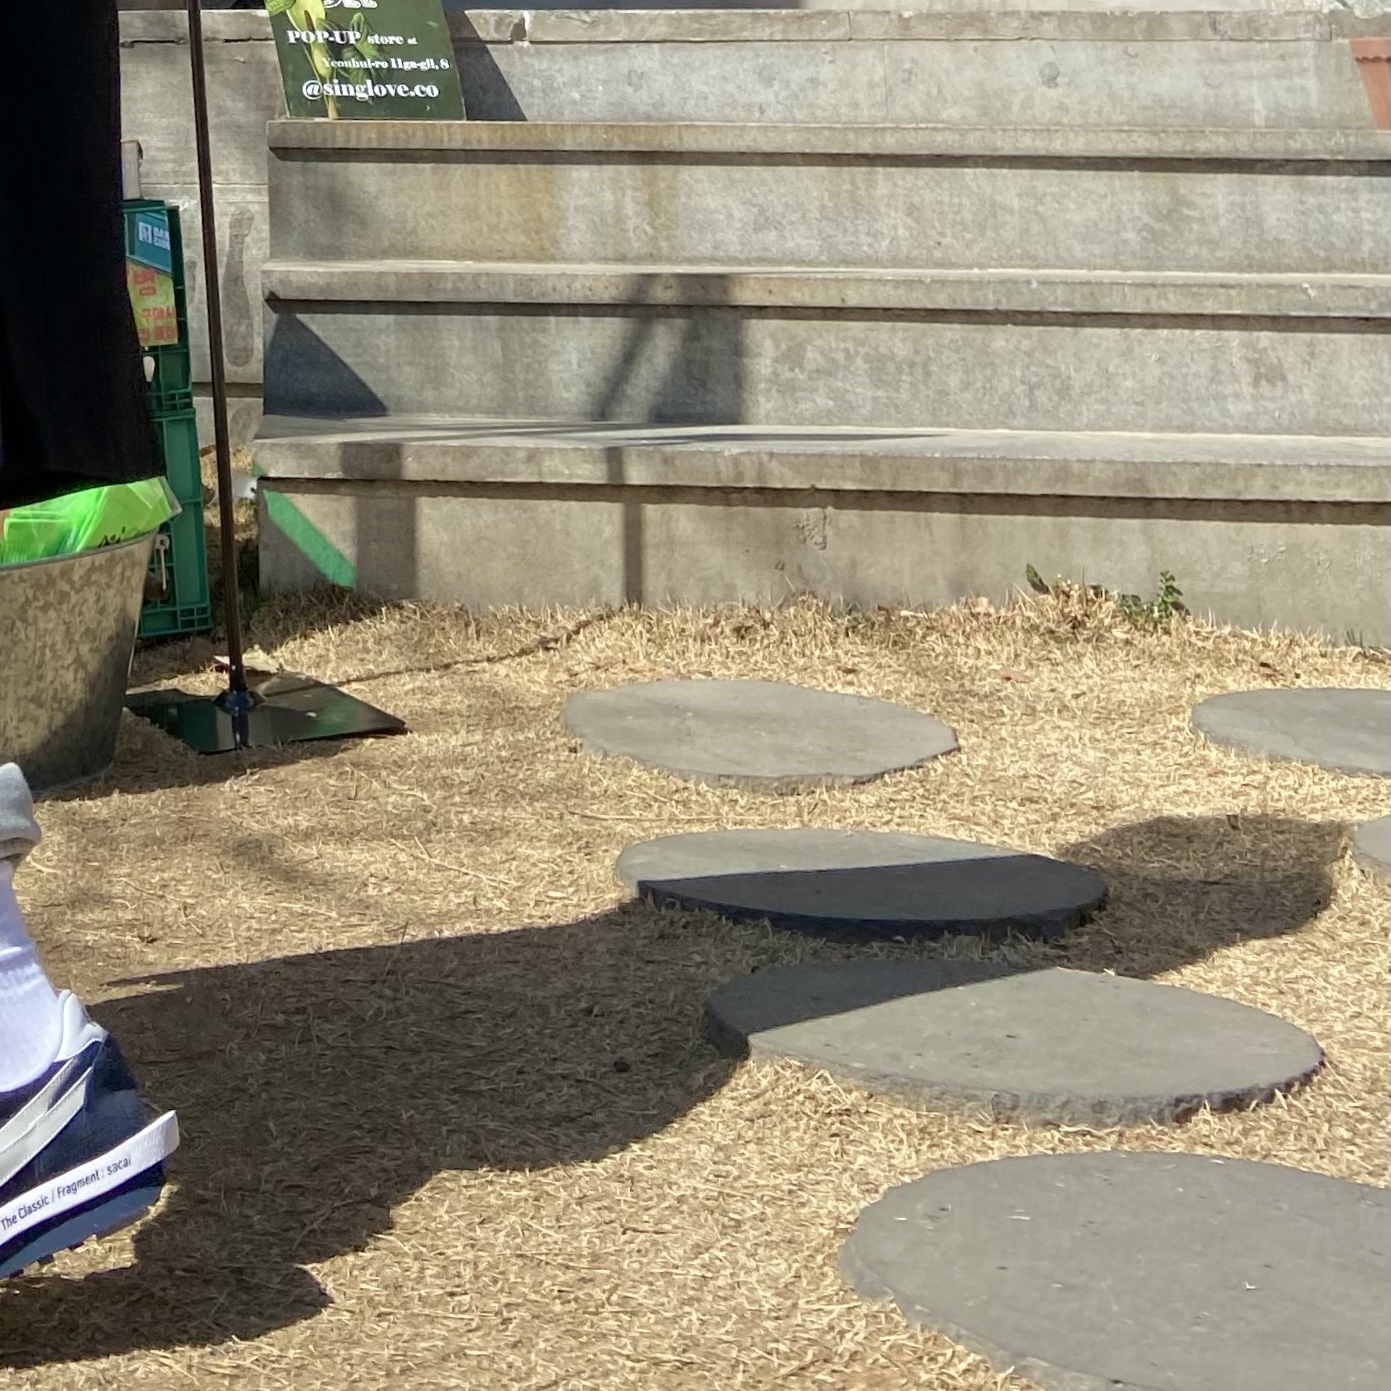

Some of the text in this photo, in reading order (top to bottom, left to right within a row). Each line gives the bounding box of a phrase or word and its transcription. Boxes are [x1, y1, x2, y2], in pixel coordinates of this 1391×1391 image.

[287, 30, 418, 45] POP-UP store at
[440, 58, 450, 70] 8
[301, 79, 439, 101] @singlove.co
[0, 1215, 18, 1231] The
[18, 1195, 49, 1219] Classic
[57, 1170, 100, 1198] Fragment
[106, 1157, 132, 1176] sacai
